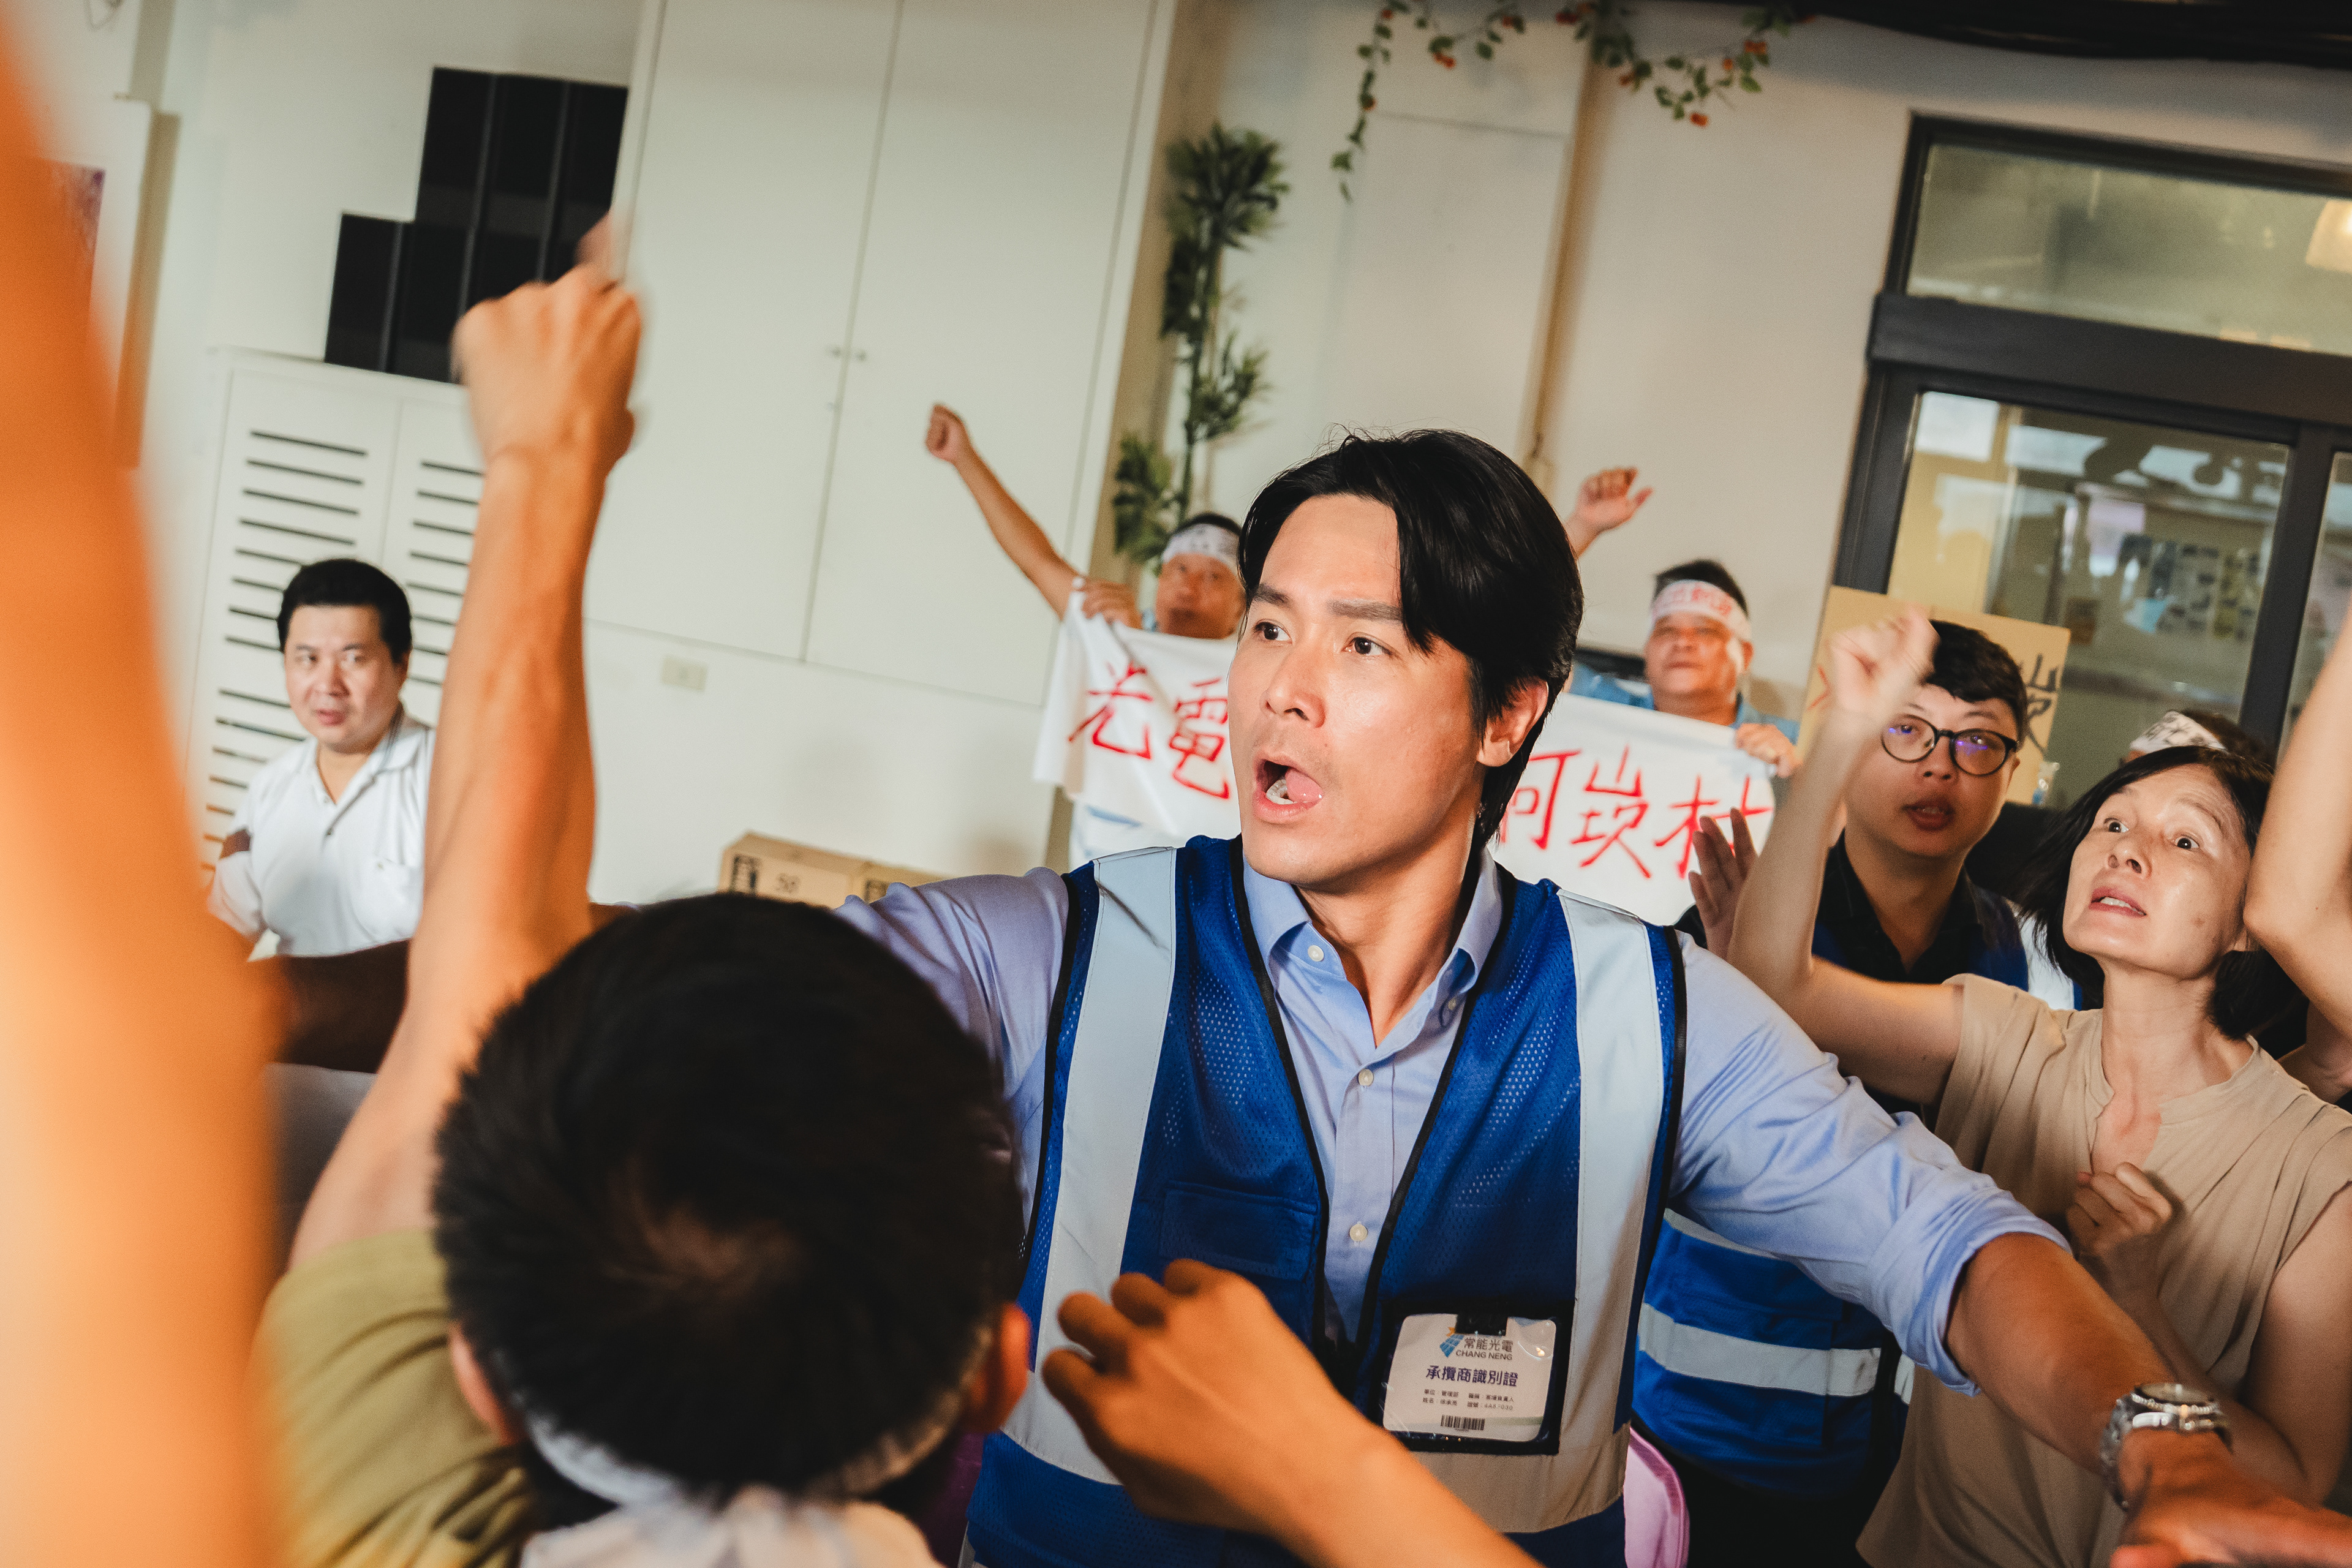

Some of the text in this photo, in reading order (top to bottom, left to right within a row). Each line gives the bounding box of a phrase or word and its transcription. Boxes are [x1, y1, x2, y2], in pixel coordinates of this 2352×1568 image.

[1067, 660, 1231, 800] 光電
[1464, 1337, 1513, 1352] 常能光電
[1456, 1351, 1513, 1360] CHANG NENG
[1425, 1365, 1518, 1387] 承攬商識別證
